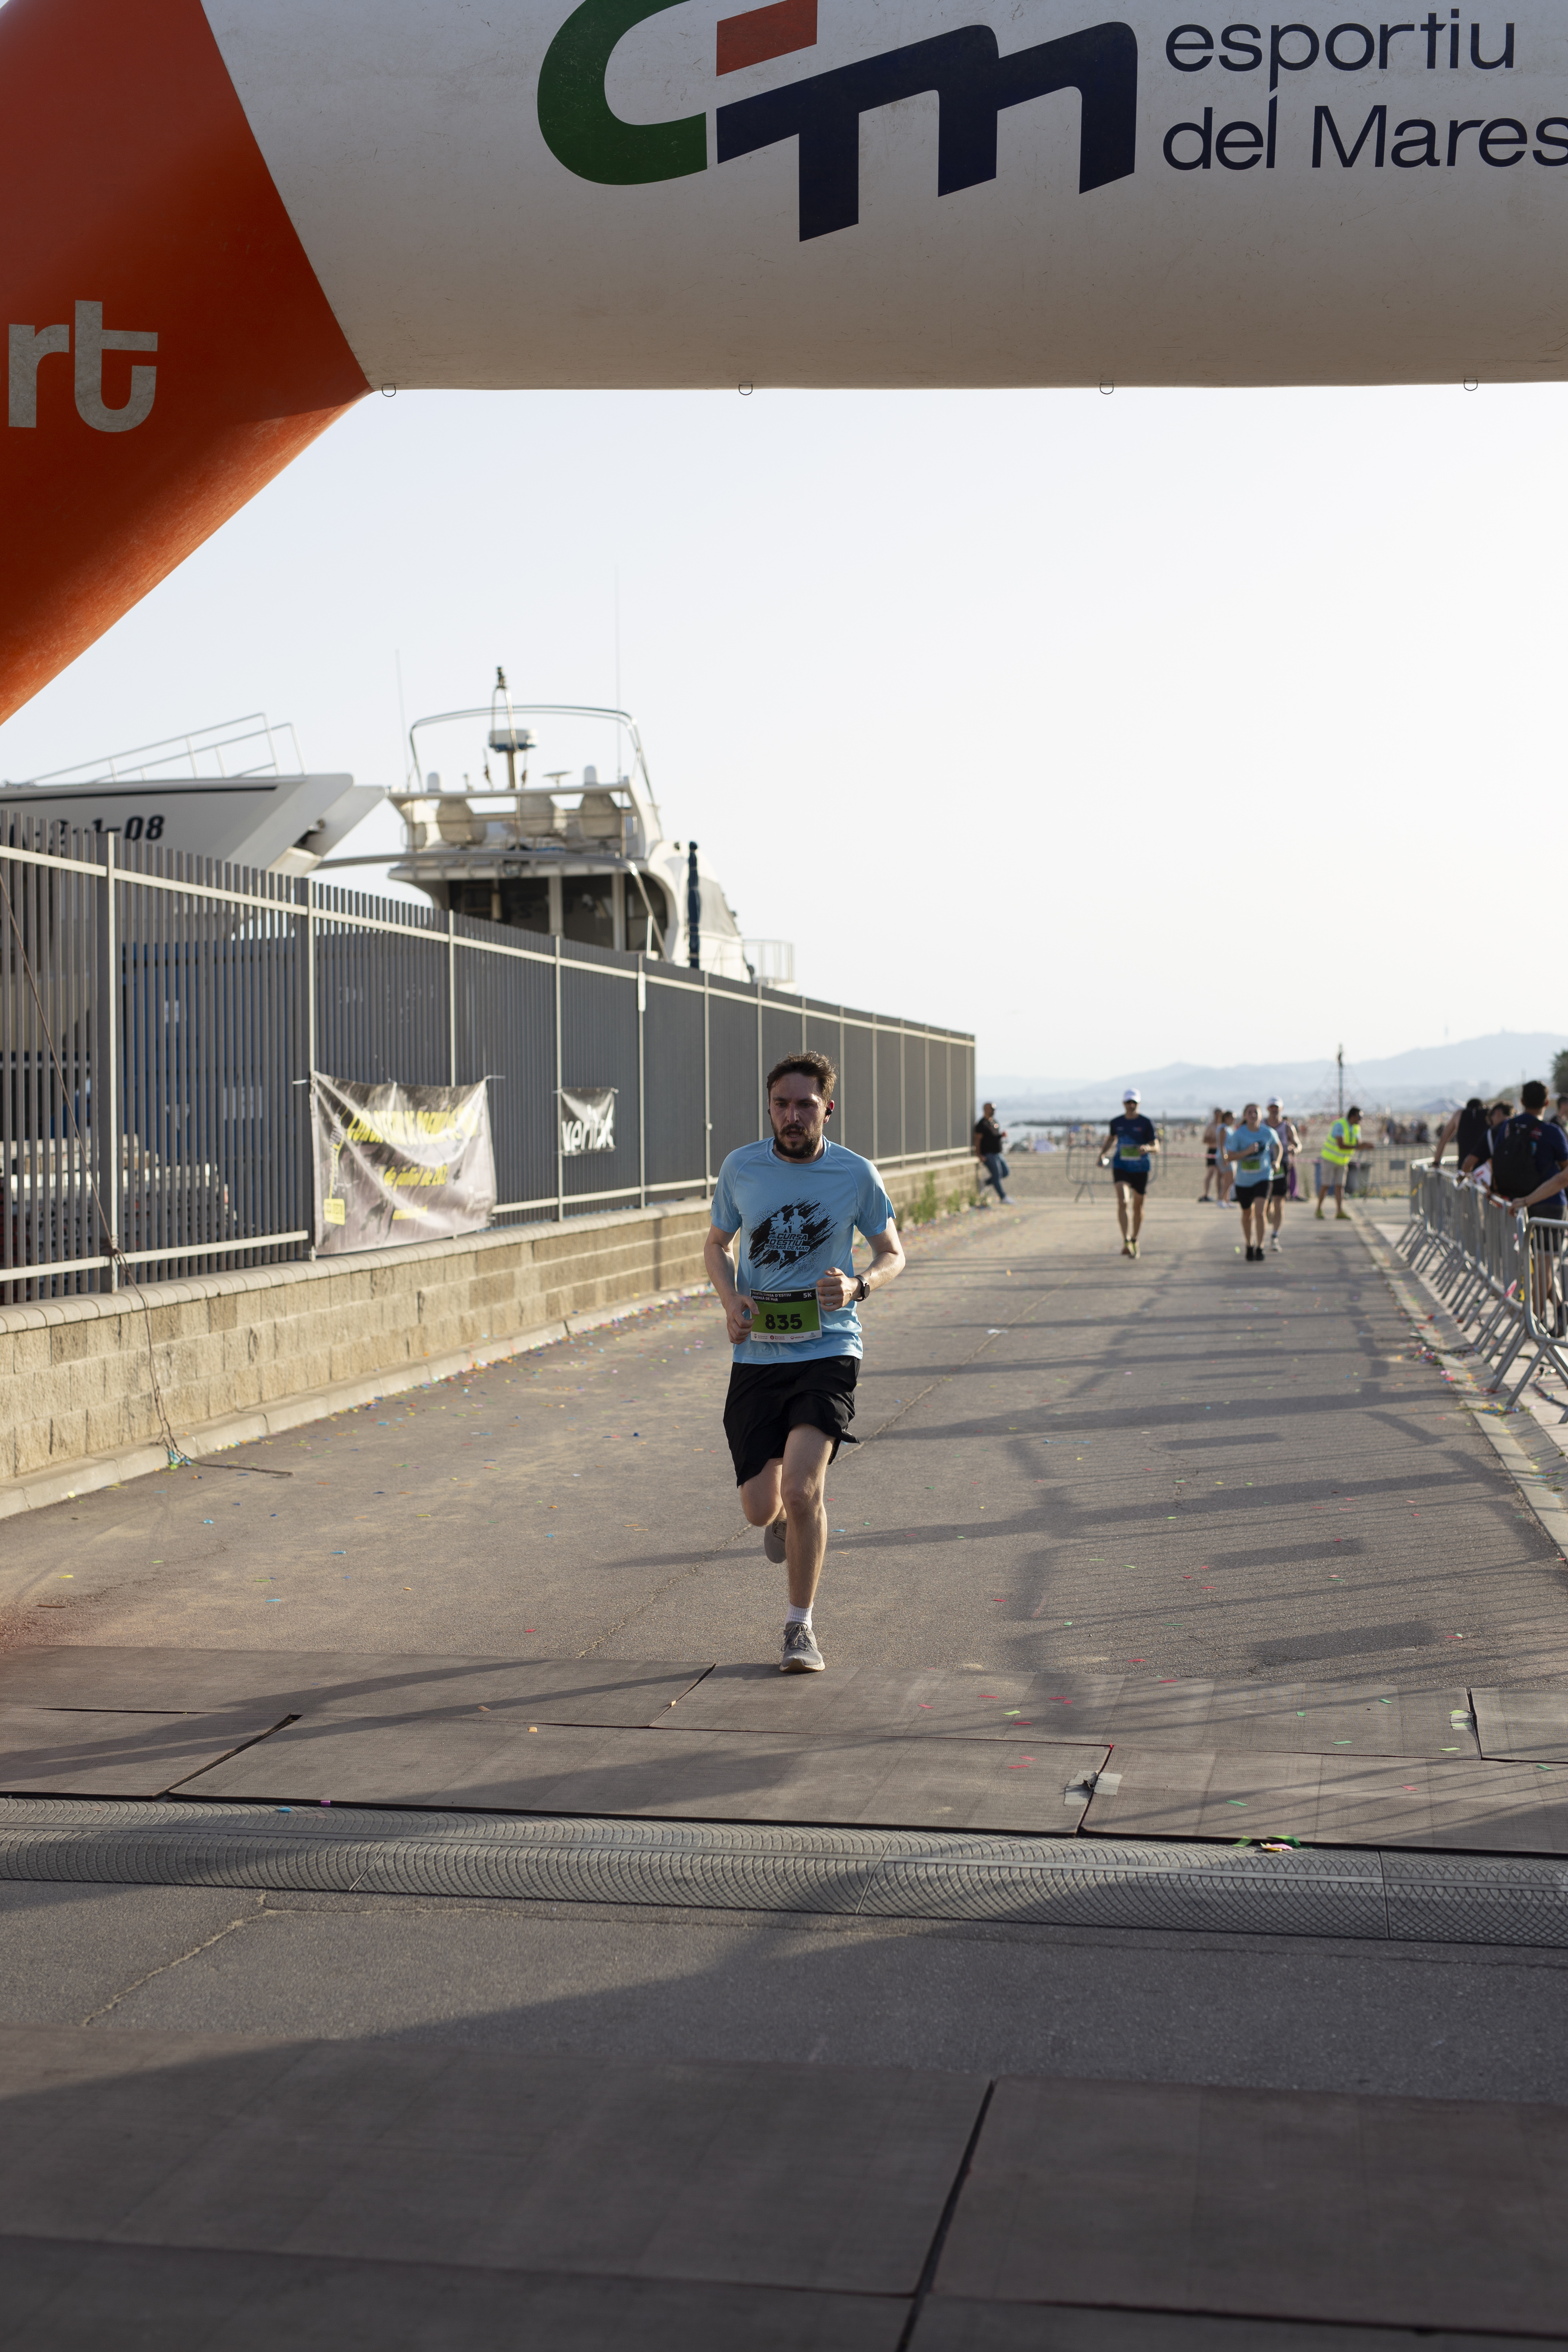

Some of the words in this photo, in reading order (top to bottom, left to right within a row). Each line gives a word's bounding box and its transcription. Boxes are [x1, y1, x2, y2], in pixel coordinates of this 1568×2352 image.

[1165, 8, 1515, 93] esportiu
[1163, 94, 1278, 171] del
[8, 299, 158, 433] rt
[765, 1313, 803, 1330] 835
